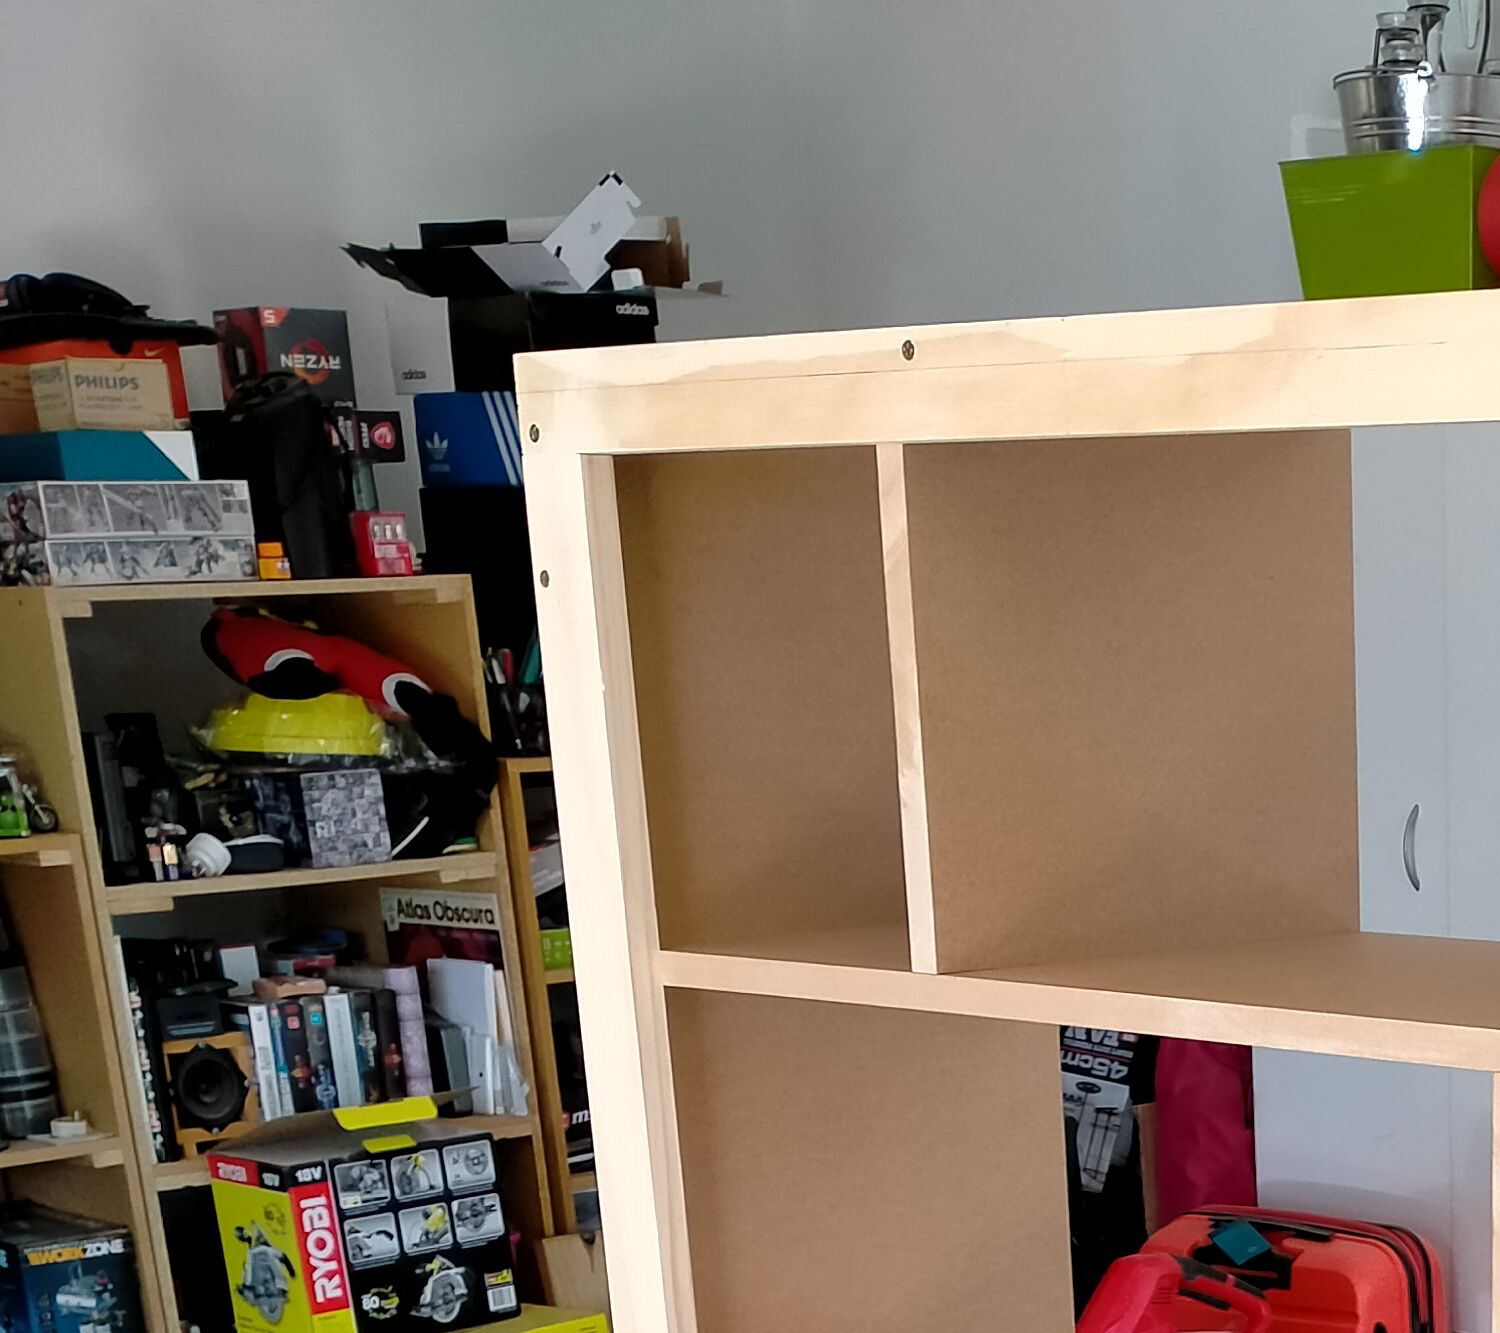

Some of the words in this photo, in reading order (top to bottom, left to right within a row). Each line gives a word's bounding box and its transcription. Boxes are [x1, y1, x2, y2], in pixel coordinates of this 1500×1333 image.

[615, 302, 650, 316] adidas
[280, 353, 342, 370] RYZEN
[74, 374, 140, 391] PHILIPS
[397, 898, 432, 920] Atlas
[432, 900, 495, 925] Obscura
[300, 1193, 345, 1304] RYOBI
